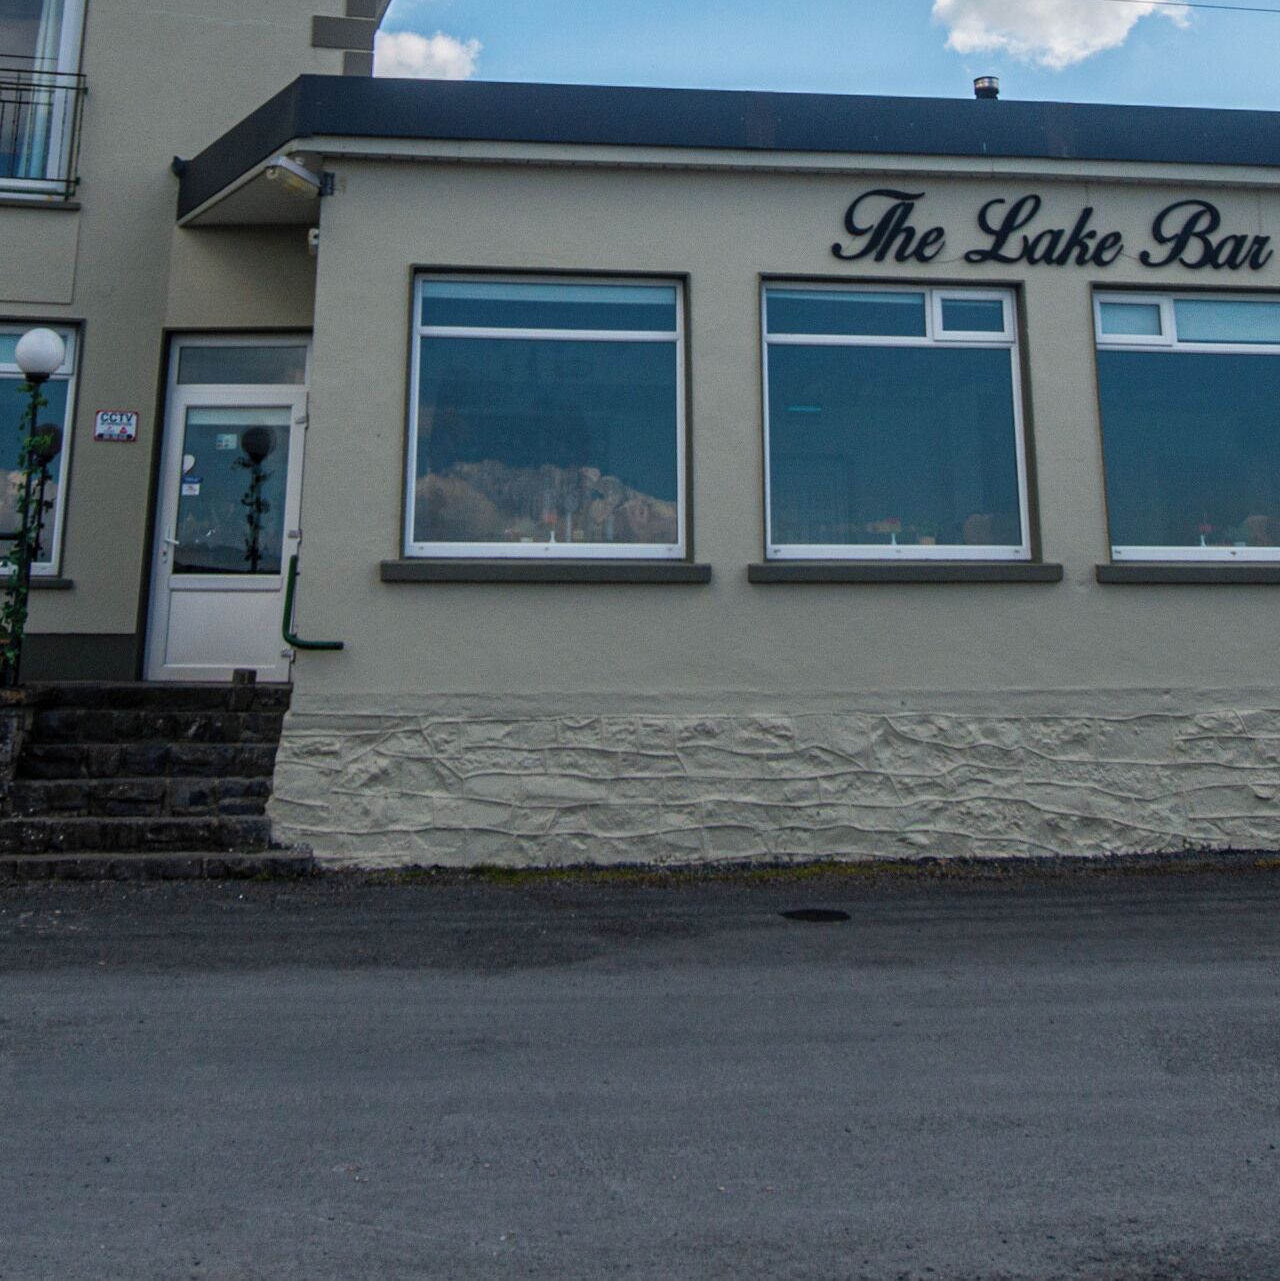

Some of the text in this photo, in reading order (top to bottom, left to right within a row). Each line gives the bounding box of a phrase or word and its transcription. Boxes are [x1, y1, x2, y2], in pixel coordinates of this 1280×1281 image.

[831, 188, 1274, 271] The Lake Bar
[100, 413, 133, 423] CCTV
